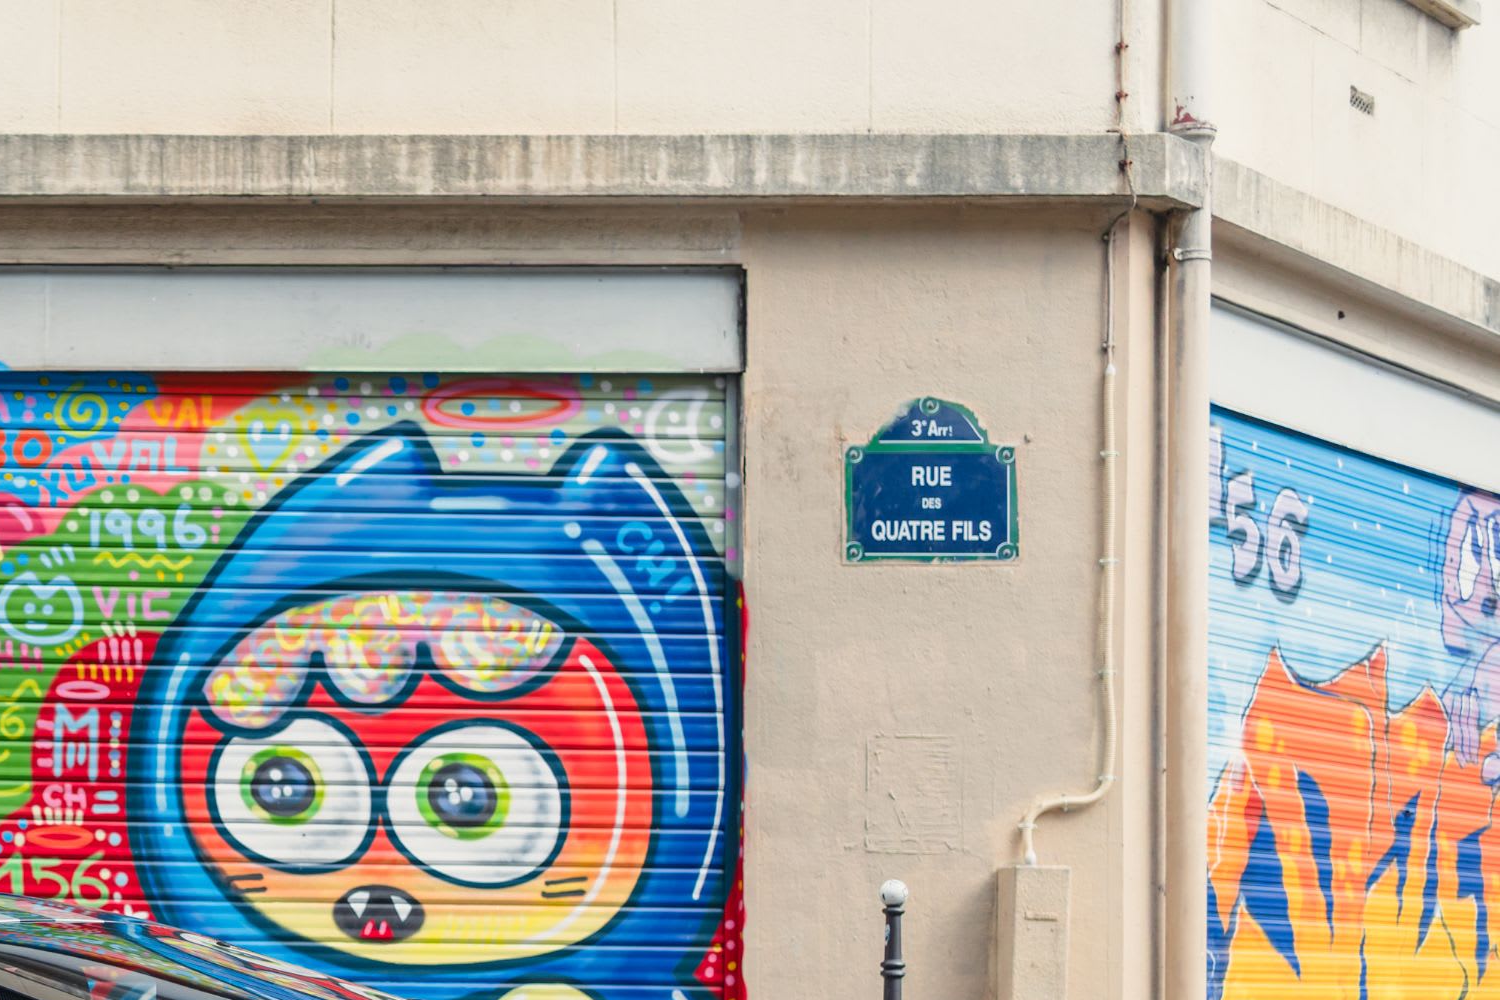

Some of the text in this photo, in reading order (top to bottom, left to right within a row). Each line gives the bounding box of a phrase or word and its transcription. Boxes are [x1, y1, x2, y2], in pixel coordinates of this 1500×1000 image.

[92, 437, 189, 475] VAL
[911, 465, 952, 487] RUE
[921, 497, 942, 509] DES
[871, 519, 993, 542] QUATRE FILS
[92, 587, 171, 620] VIC
